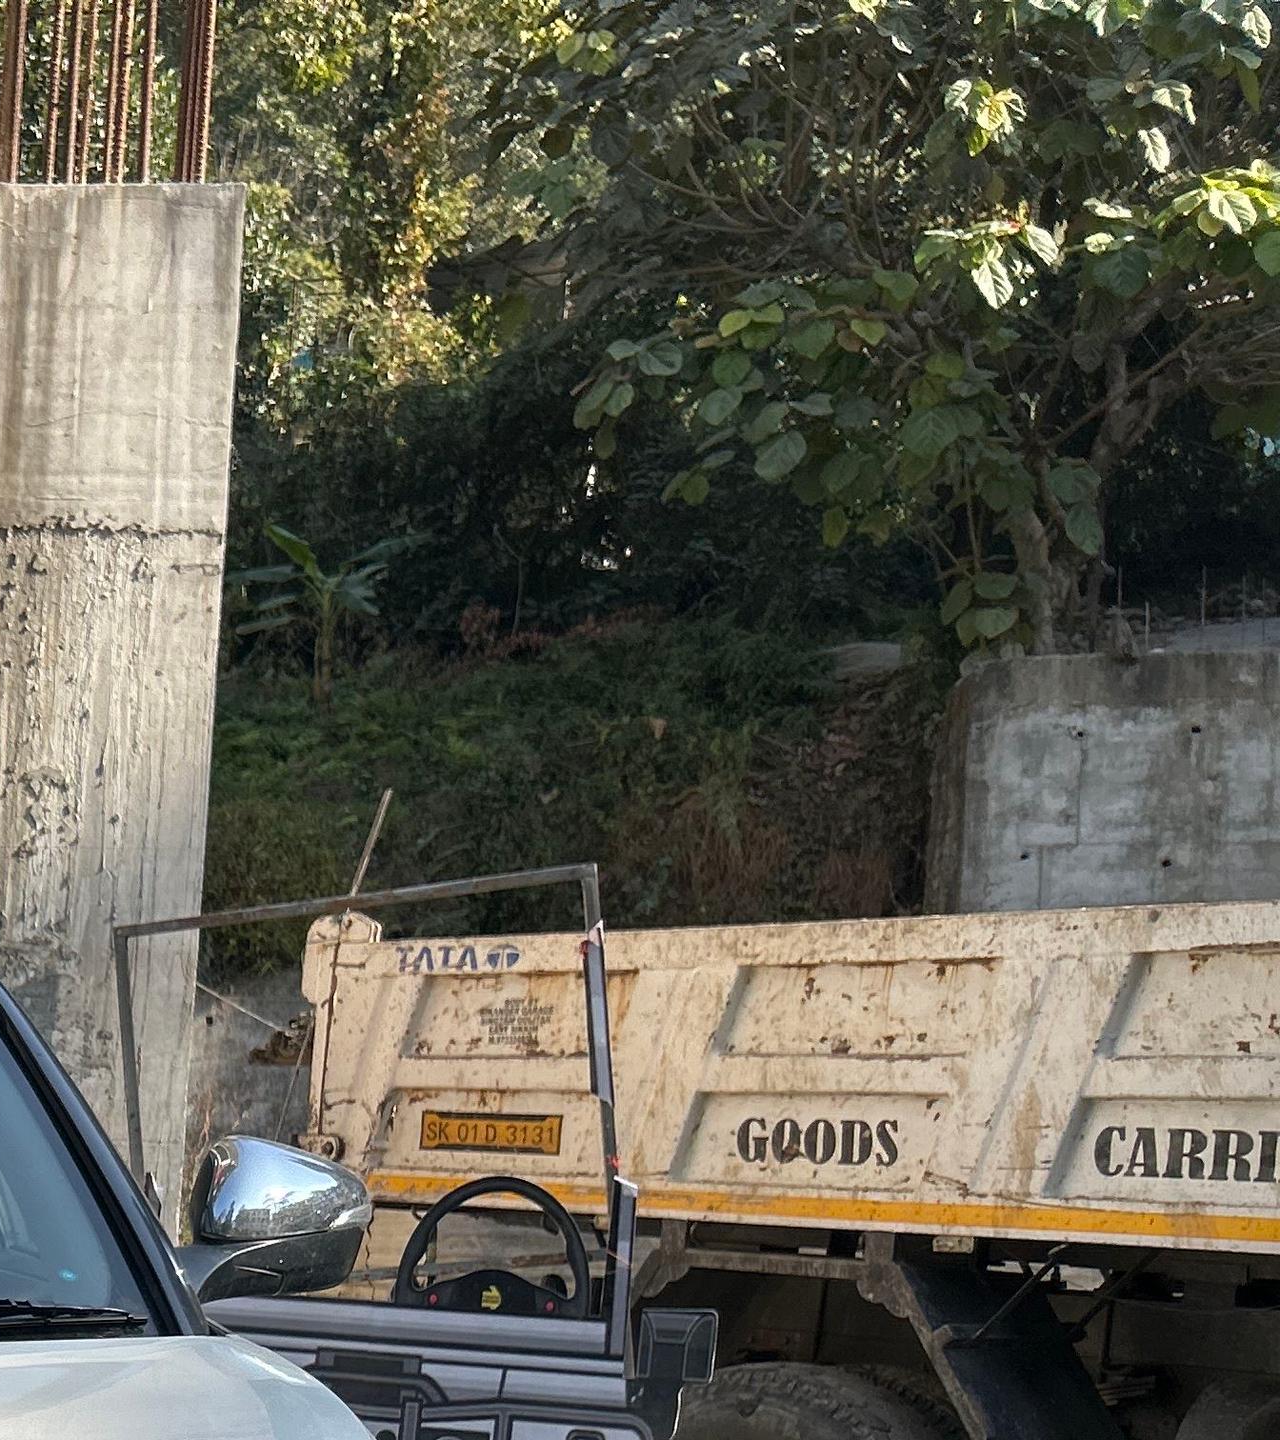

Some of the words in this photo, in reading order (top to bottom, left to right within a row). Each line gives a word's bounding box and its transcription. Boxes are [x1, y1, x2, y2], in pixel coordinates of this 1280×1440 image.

[396, 946, 479, 974] TATA
[426, 1122, 450, 1140] SK
[457, 1124, 478, 1142] 01
[485, 1125, 497, 1143] D
[506, 1126, 554, 1146] 3131
[736, 1117, 900, 1167] GOODS
